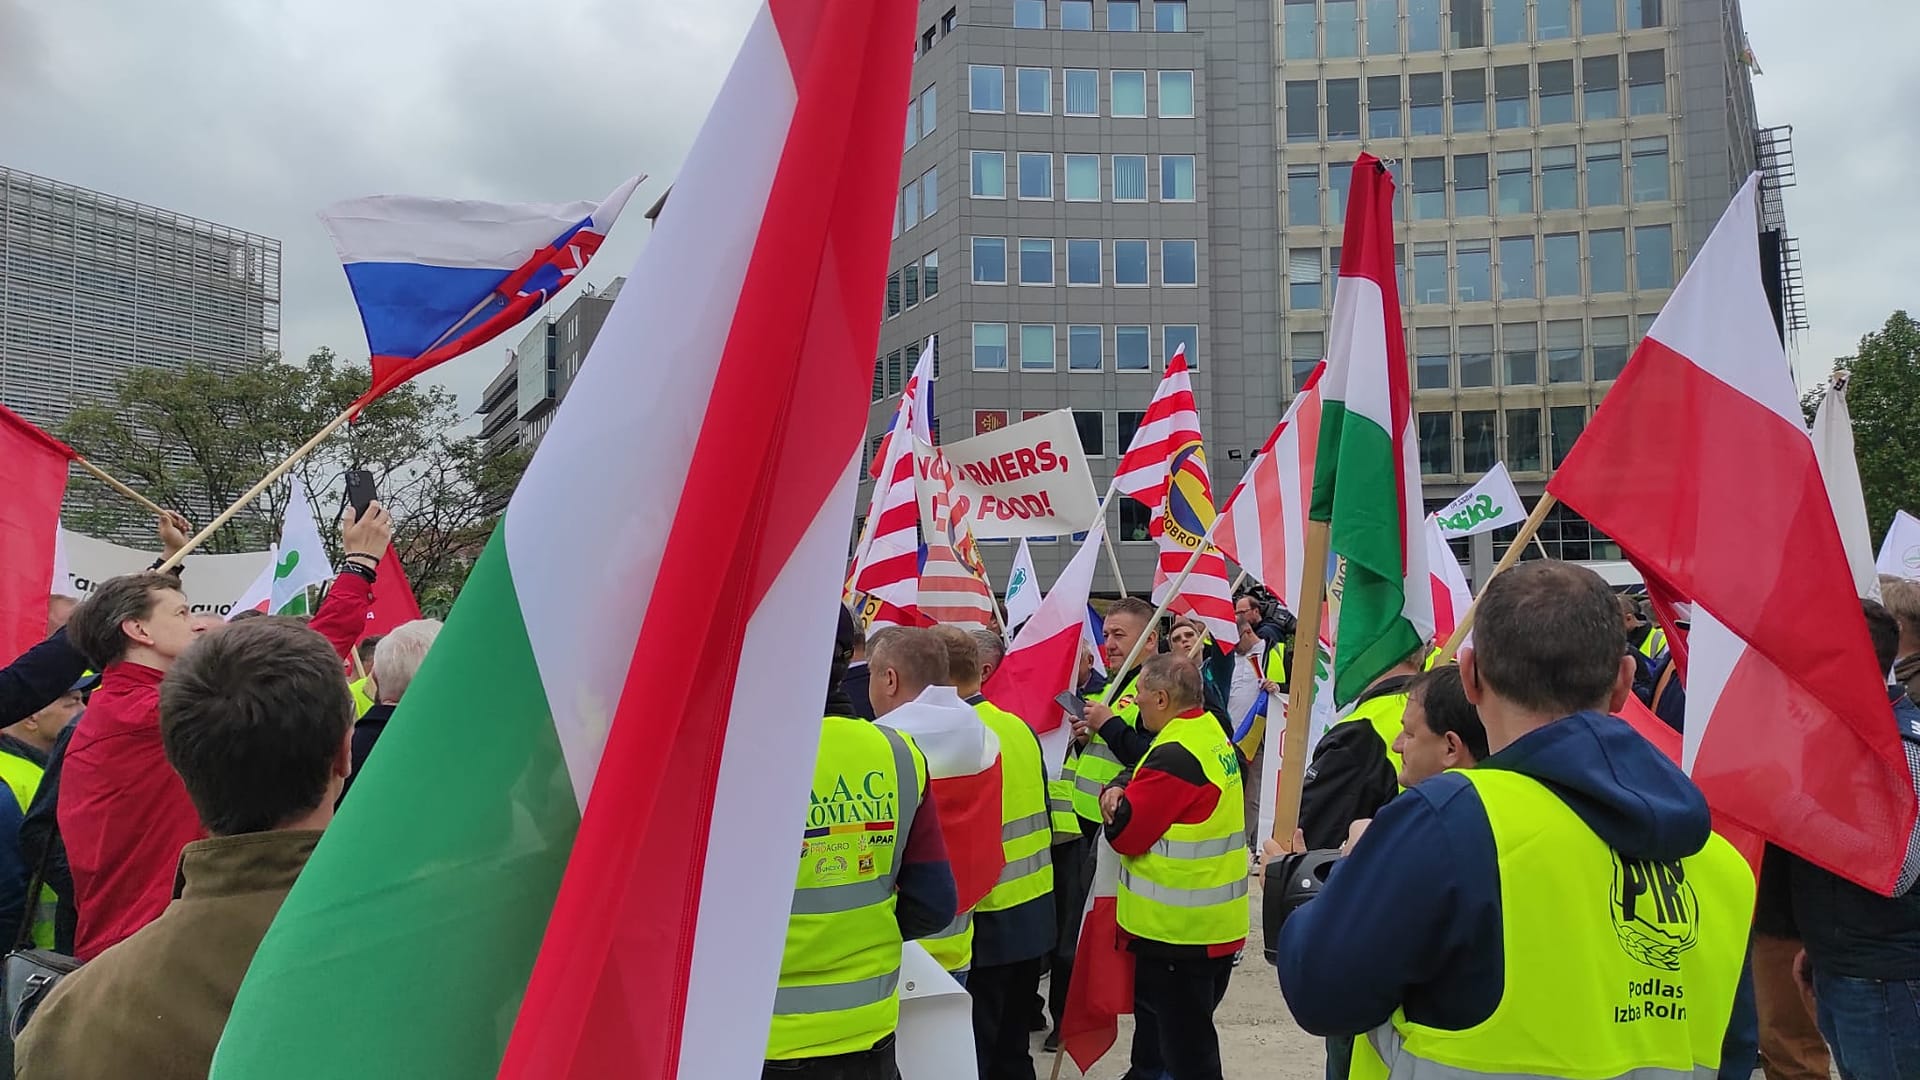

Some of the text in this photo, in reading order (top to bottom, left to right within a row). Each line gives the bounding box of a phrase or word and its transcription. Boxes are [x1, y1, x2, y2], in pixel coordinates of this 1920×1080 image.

[976, 490, 1055, 521] FOOD!
[868, 835, 894, 845] APAR
[1628, 979, 1684, 998] Podlas
[1614, 1004, 1641, 1023] Izba
